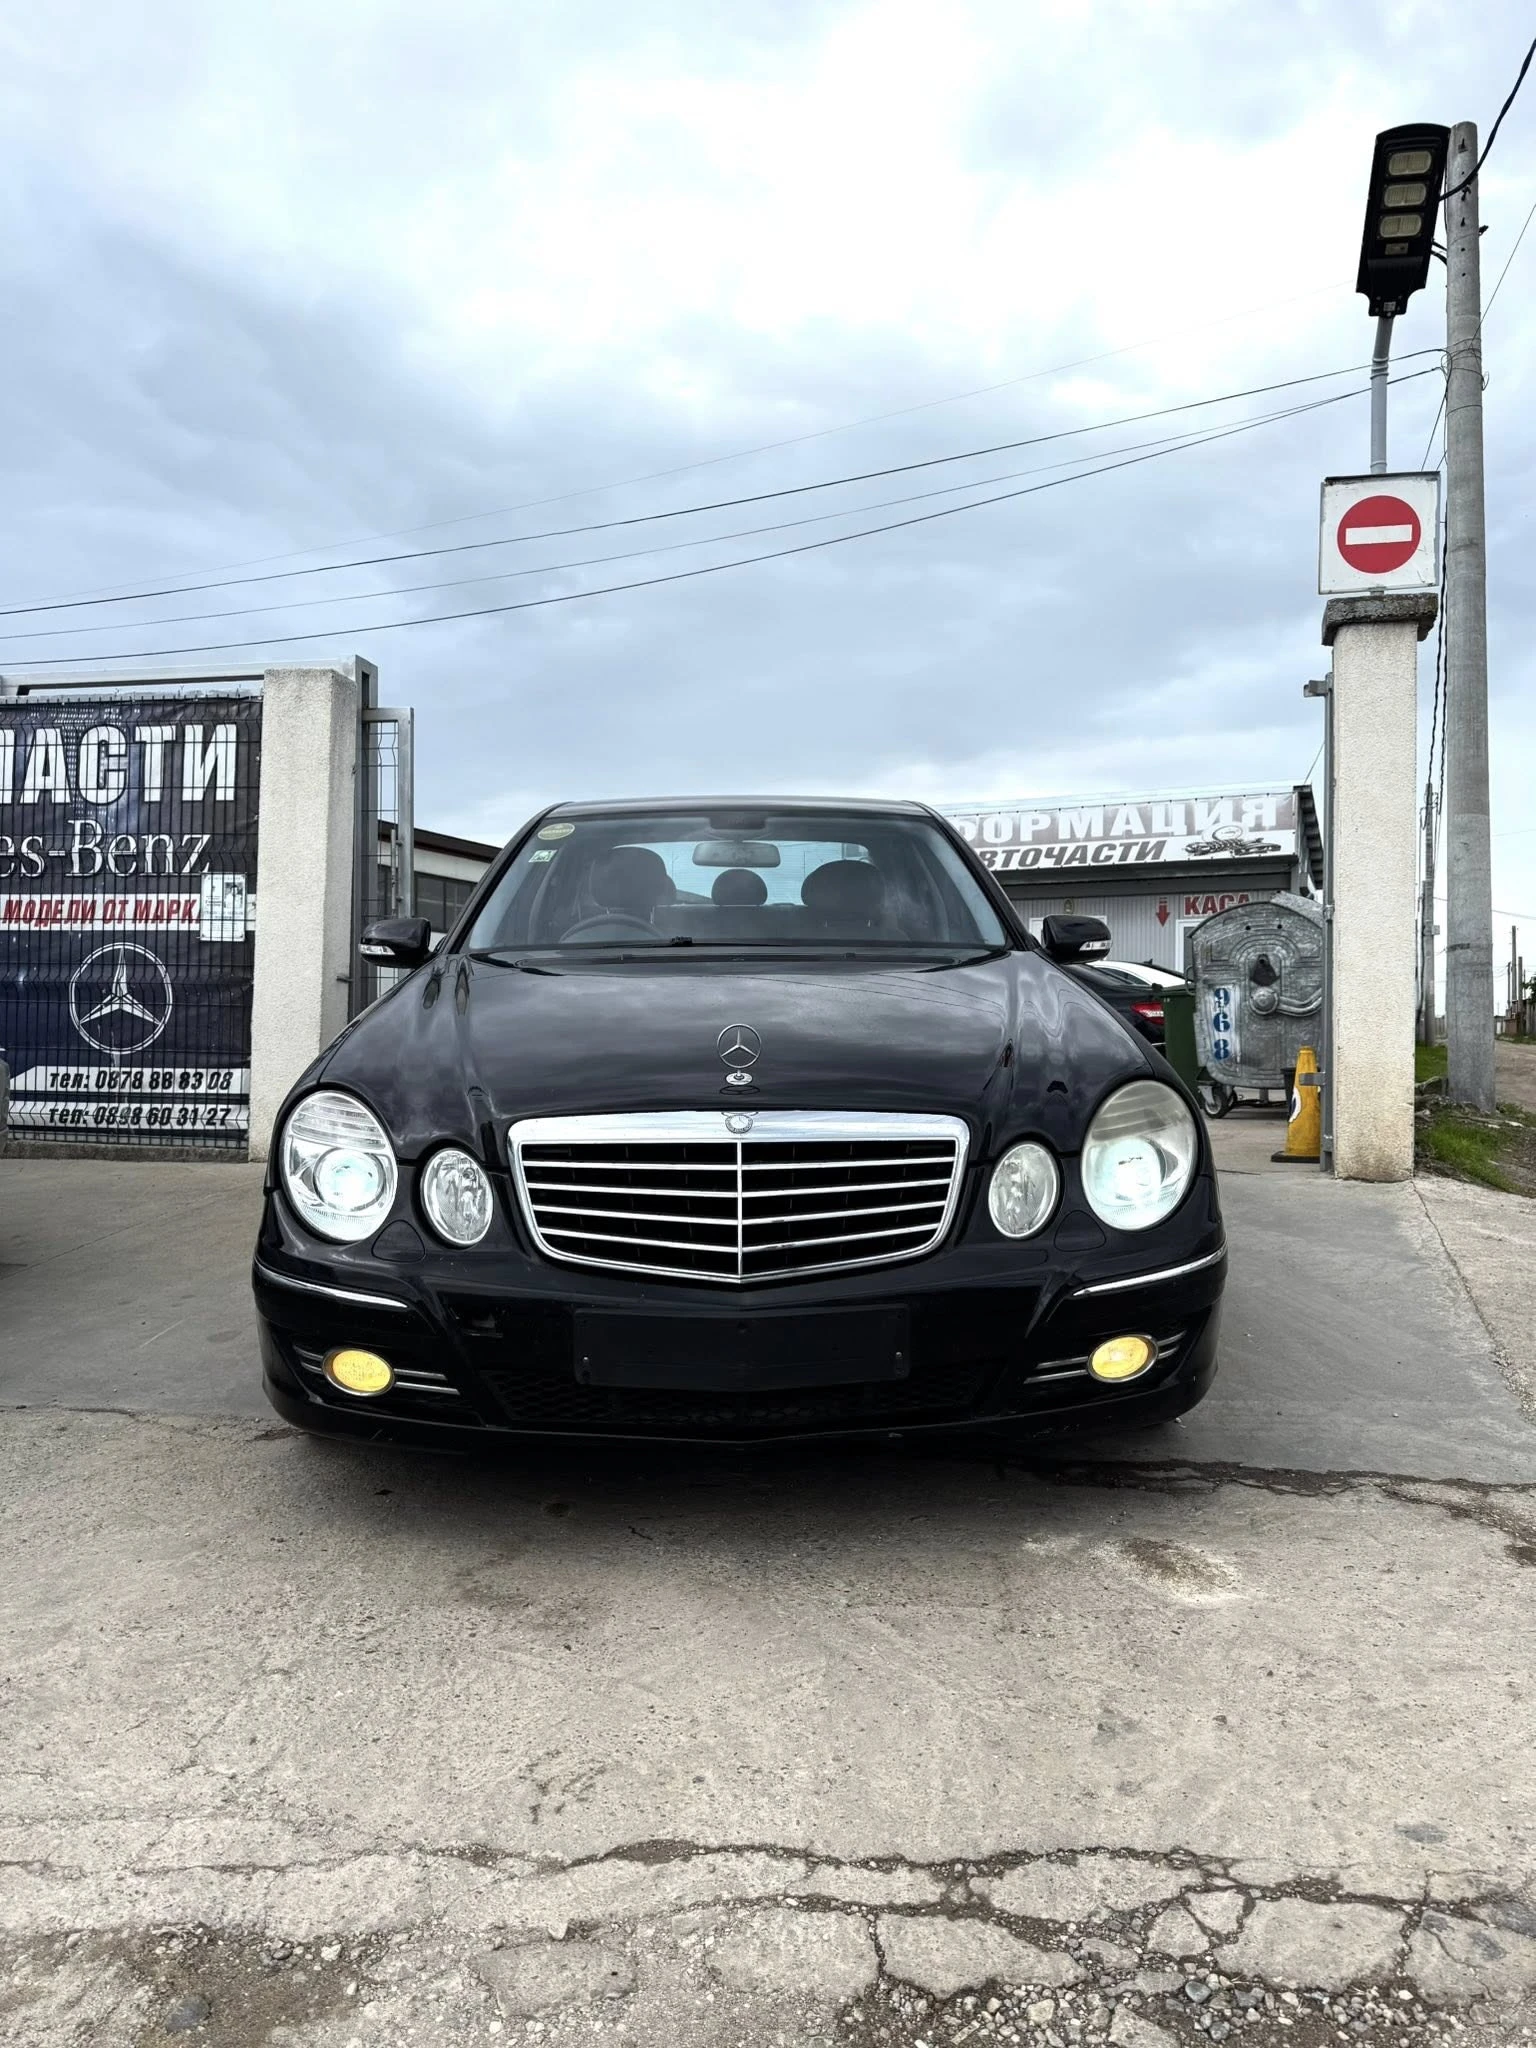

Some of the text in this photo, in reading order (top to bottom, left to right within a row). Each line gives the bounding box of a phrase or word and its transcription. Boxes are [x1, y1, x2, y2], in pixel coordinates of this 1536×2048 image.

[2, 899, 200, 927] МОДЕЛИ ОТ МАРК
[50, 1070, 234, 1090] тел: 0878 88 83 08
[147, 1107, 173, 1126] 60
[176, 1108, 200, 1127] 31
[206, 1108, 231, 1127] 27
